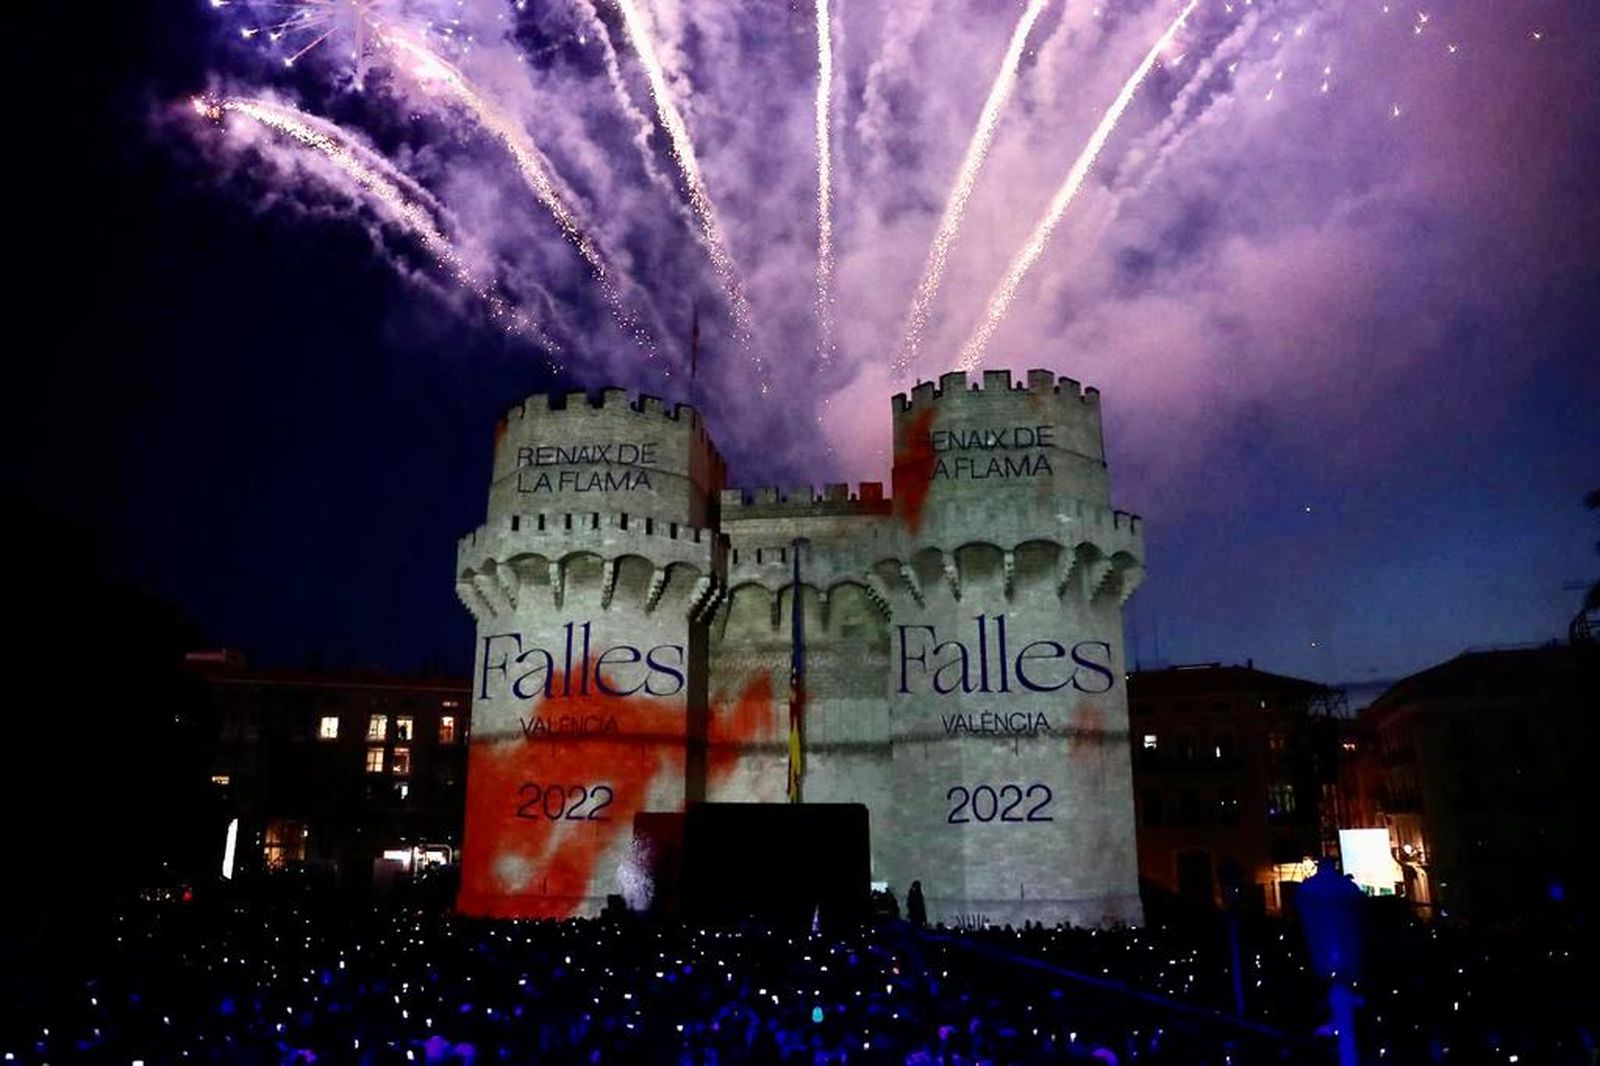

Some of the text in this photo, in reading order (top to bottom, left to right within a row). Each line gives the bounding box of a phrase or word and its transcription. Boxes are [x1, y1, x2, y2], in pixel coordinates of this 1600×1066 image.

[516, 442, 659, 467] RENAIX DE
[920, 426, 1055, 452] ENAIX DE
[516, 470, 653, 493] LA FLAMA
[955, 454, 1053, 479] FLAMA
[477, 620, 685, 700] Falles
[896, 614, 1115, 695] Falles
[515, 782, 614, 822] 2022
[946, 784, 1054, 824] 2022
